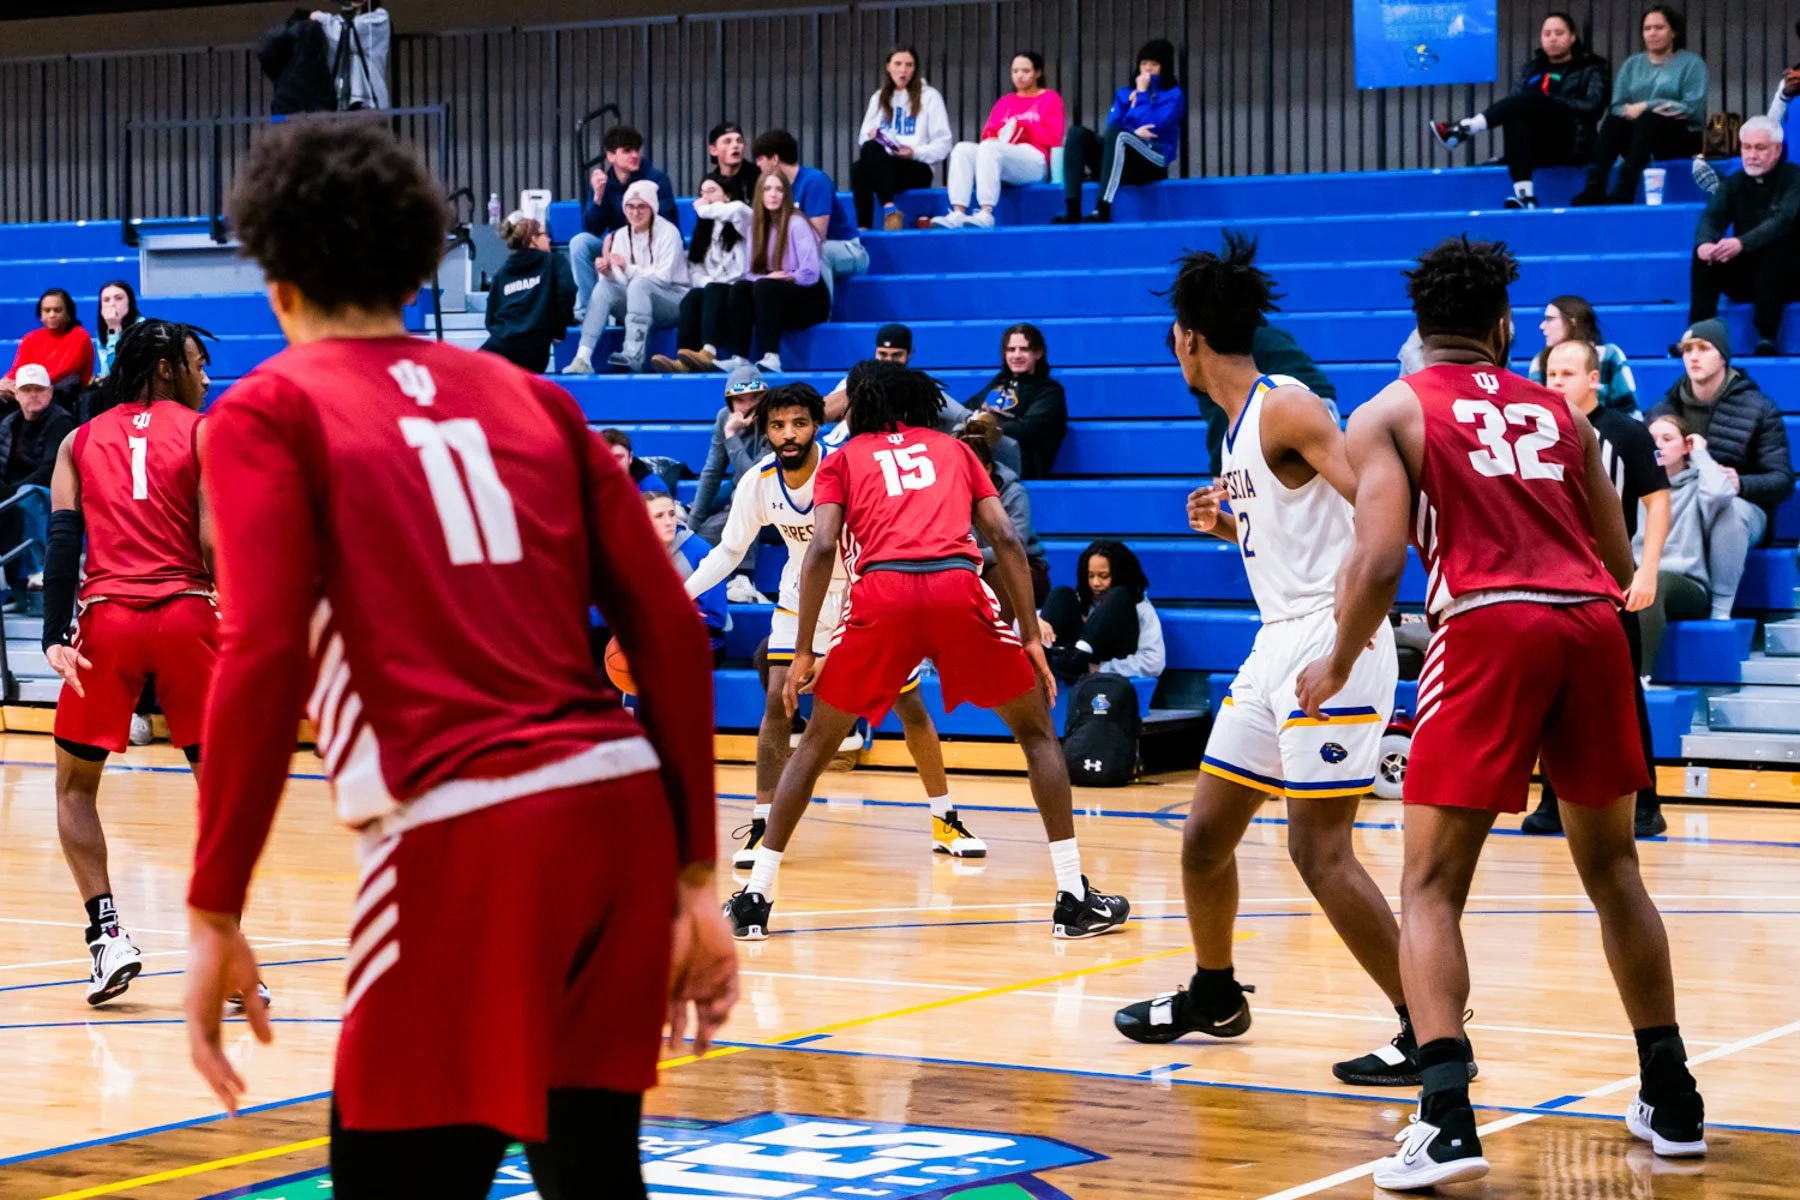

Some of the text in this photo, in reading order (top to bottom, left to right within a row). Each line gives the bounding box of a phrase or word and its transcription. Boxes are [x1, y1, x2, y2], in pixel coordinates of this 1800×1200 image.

[128, 435, 148, 500] 1
[1452, 399, 1564, 481] 32
[397, 416, 524, 566] 11
[873, 443, 937, 497] 15
[780, 523, 814, 543] BRES
[1239, 511, 1256, 557] 2
